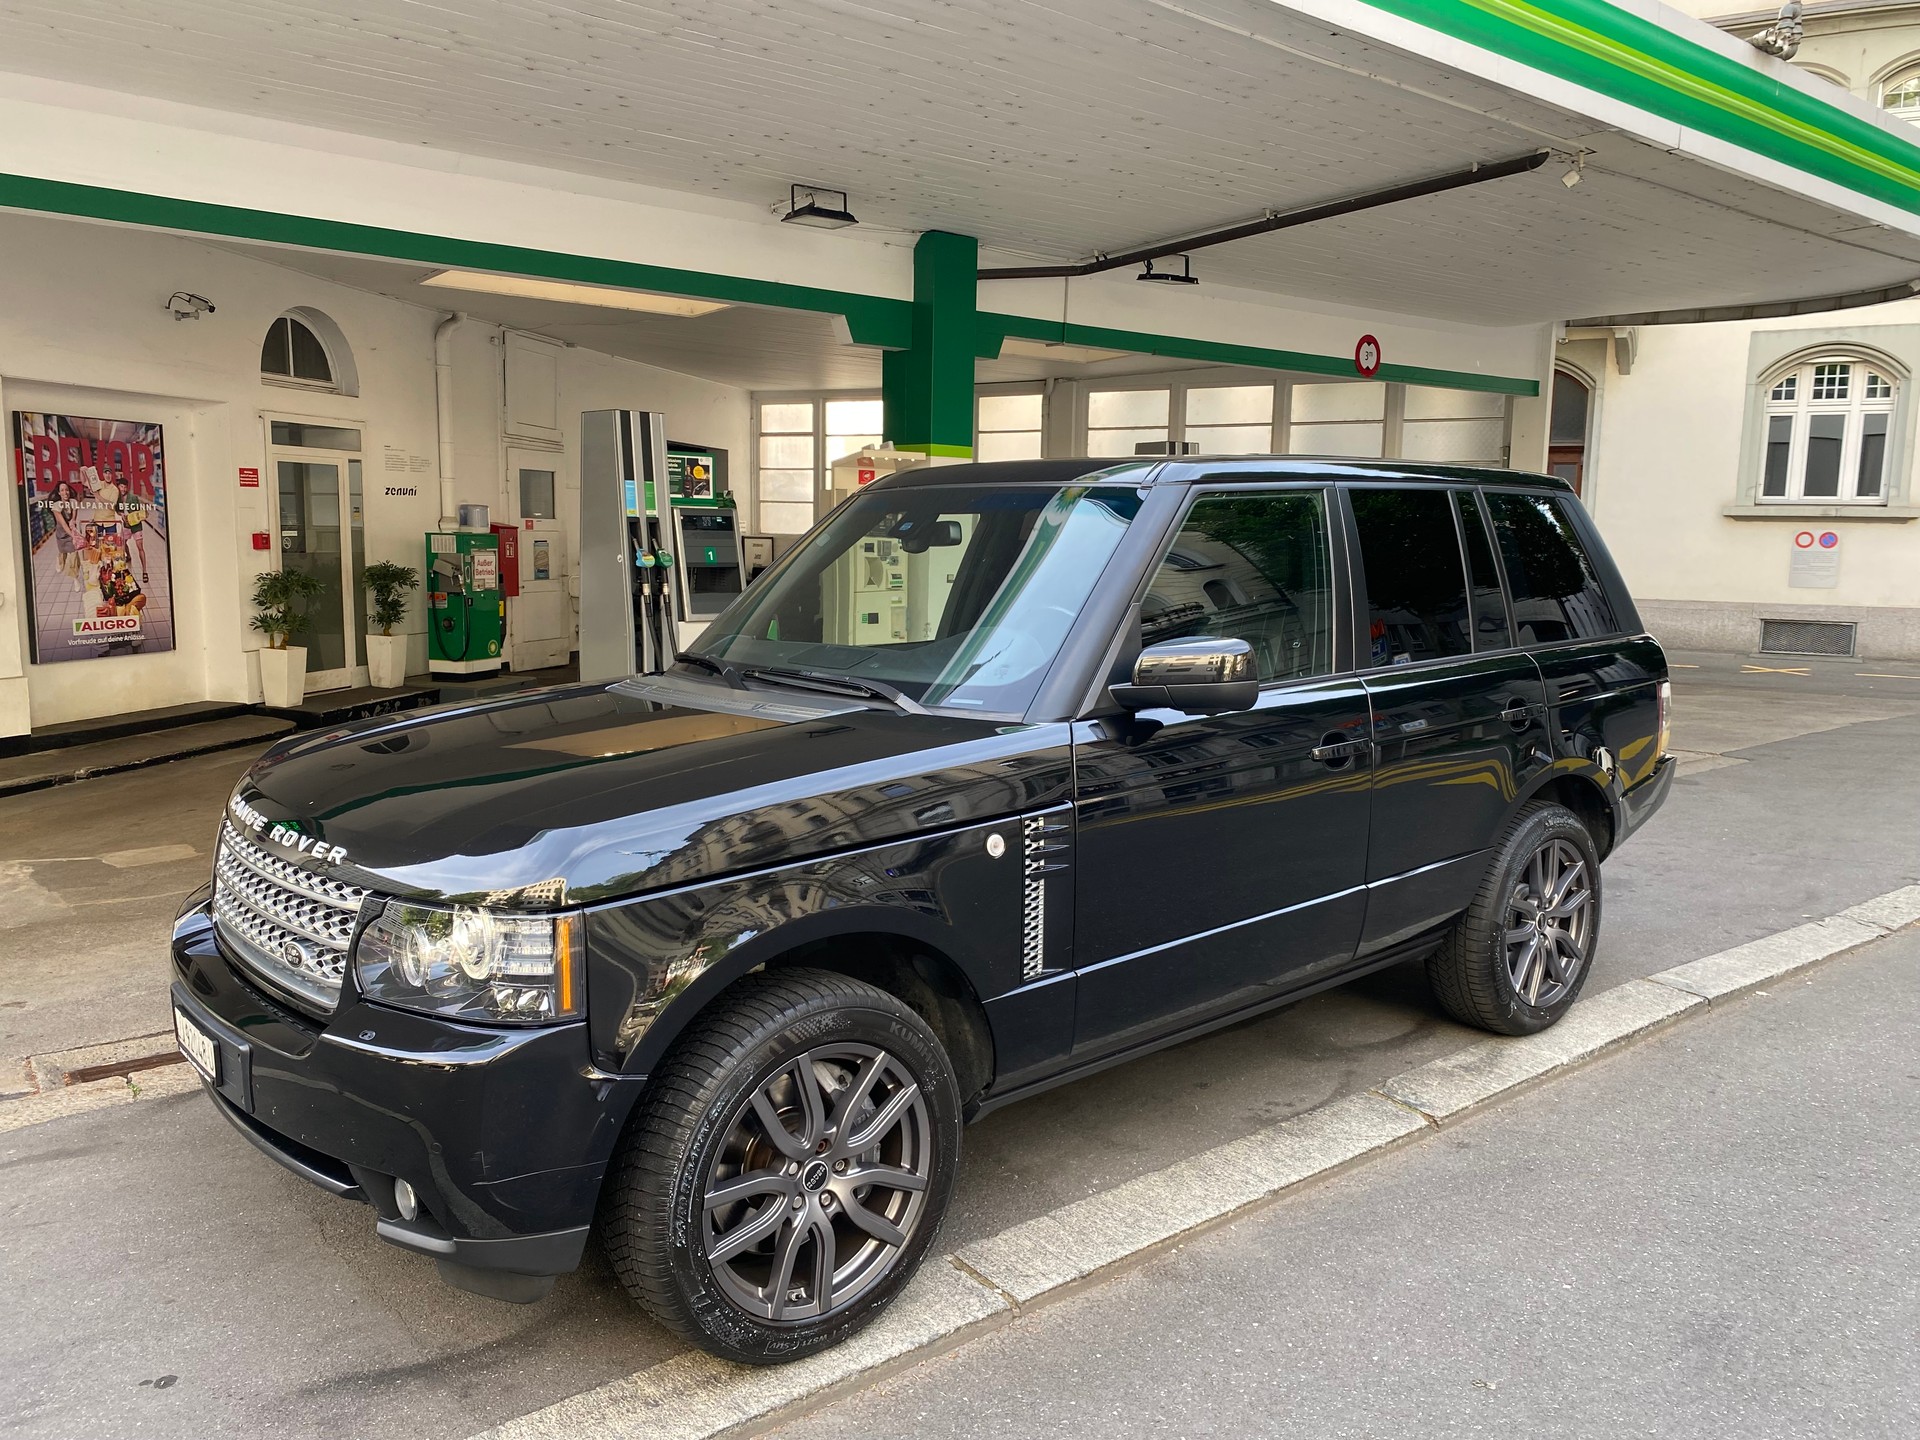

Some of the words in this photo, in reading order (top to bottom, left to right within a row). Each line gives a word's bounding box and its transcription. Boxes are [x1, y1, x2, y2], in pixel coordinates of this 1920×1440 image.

[32, 435, 156, 496] BEVOR
[385, 485, 417, 496] zenuni
[37, 500, 54, 509] DIE
[58, 501, 115, 510] GRILLPARTY
[118, 502, 158, 511] BEGINNT
[707, 551, 714, 561] 1
[475, 568, 494, 576] Betrieb
[81, 618, 137, 632] ALIGRO
[67, 637, 97, 646] Vorfreude
[107, 635, 124, 643] deine
[230, 793, 269, 832] RANGE
[268, 824, 348, 865] ROVER
[889, 1021, 939, 1071] KUMHO
